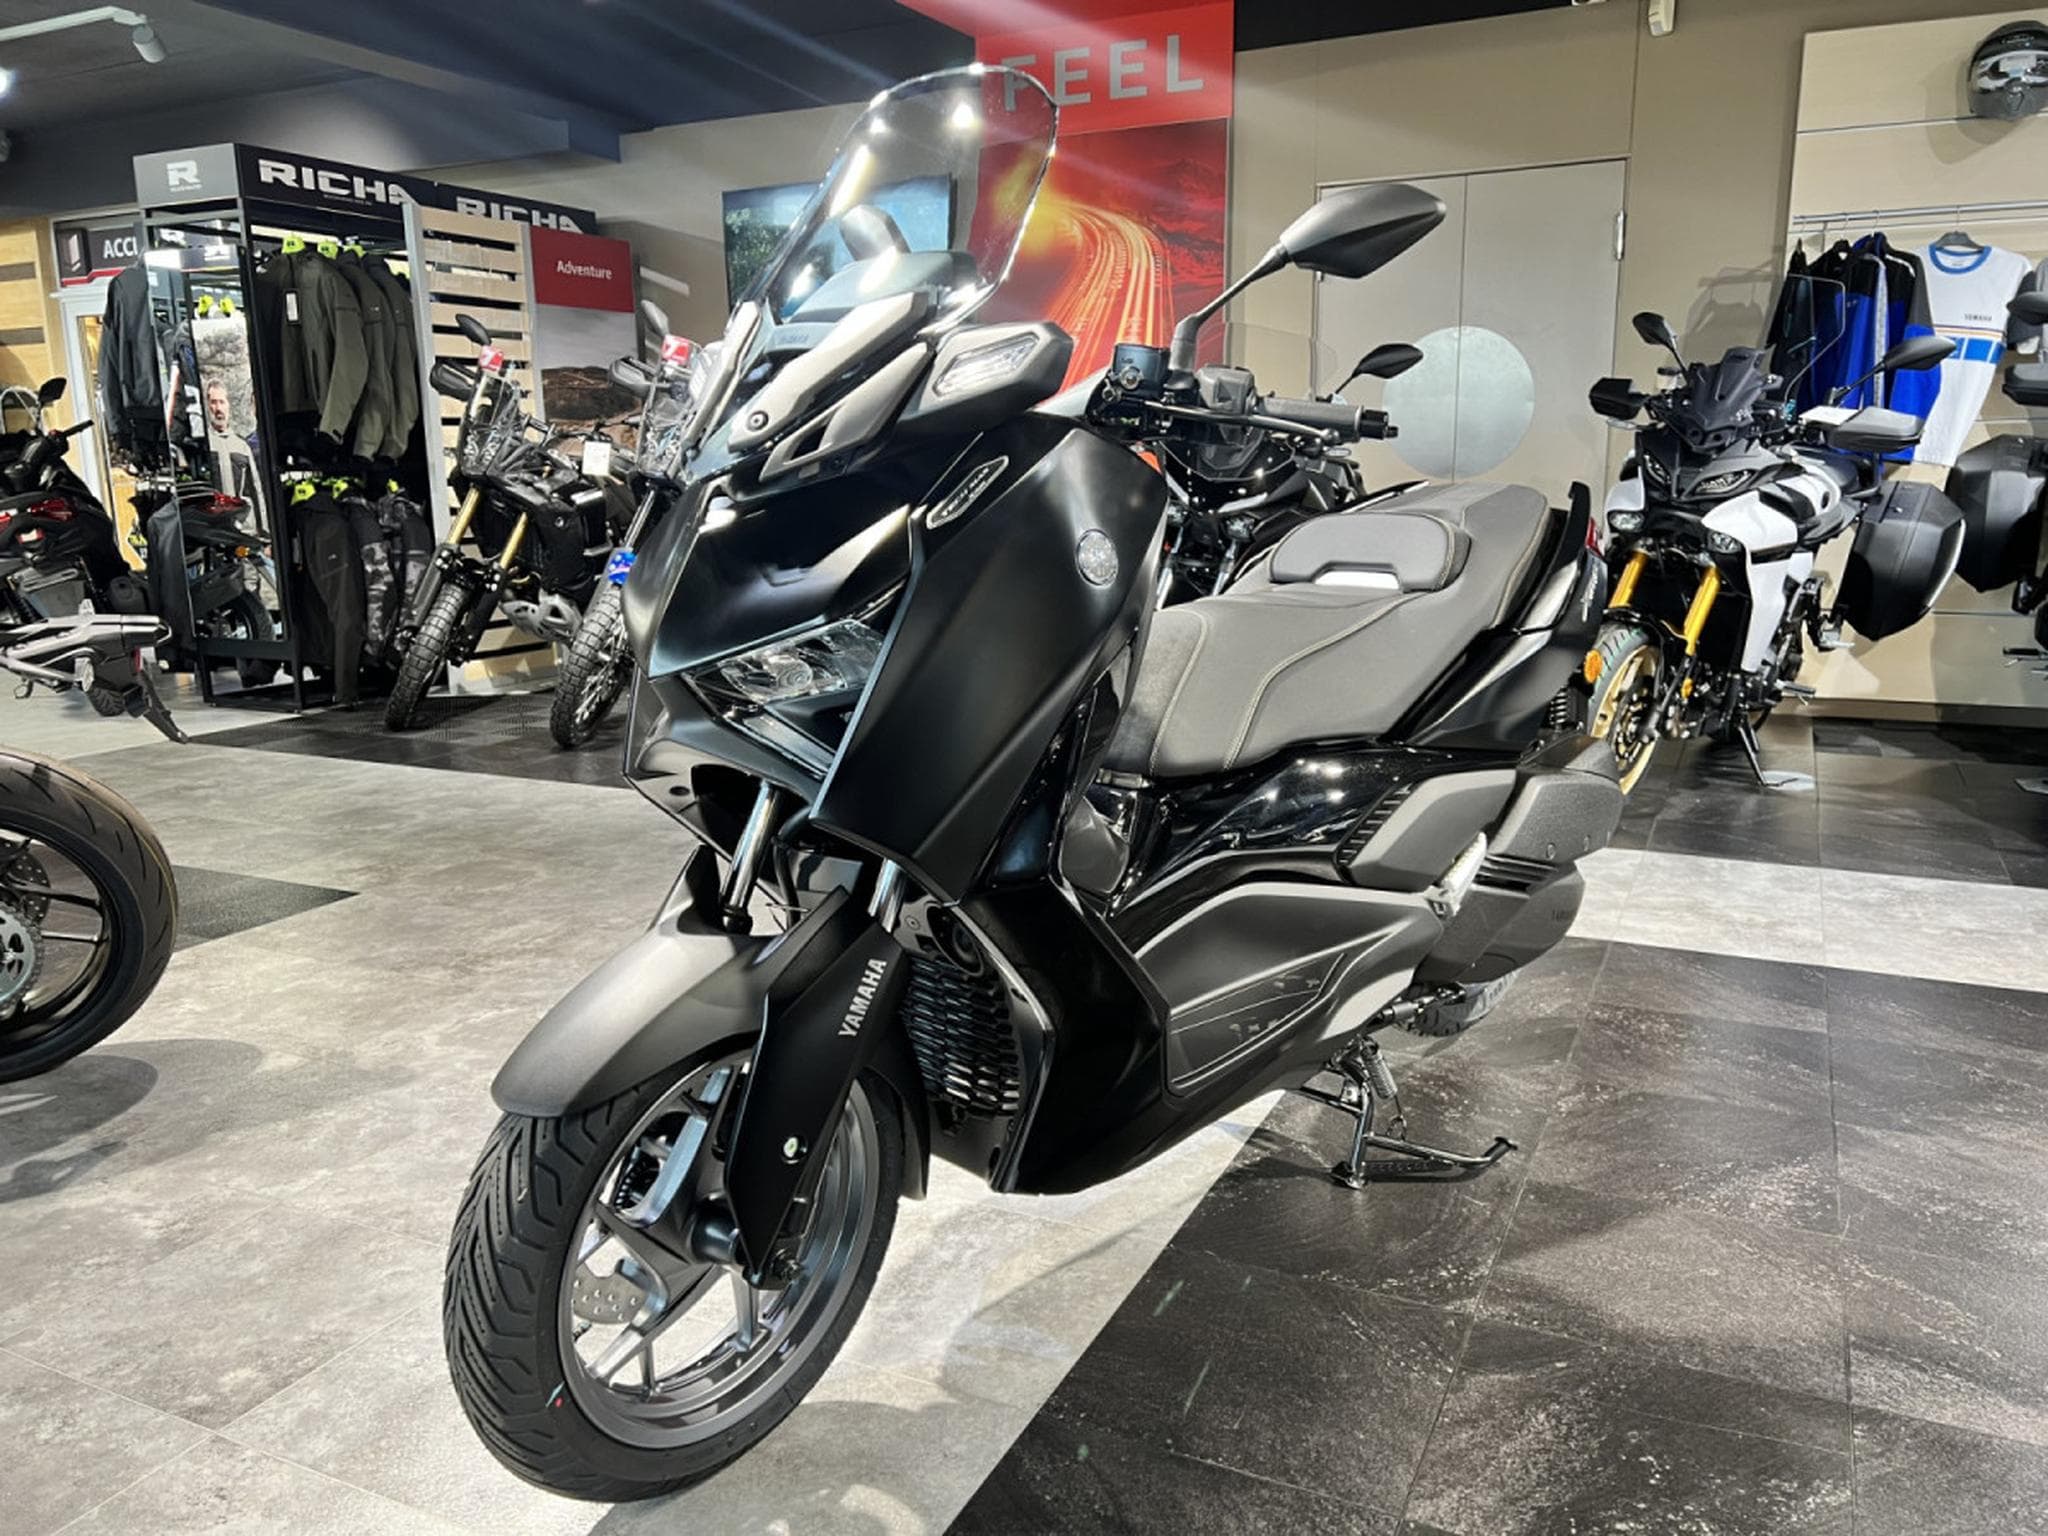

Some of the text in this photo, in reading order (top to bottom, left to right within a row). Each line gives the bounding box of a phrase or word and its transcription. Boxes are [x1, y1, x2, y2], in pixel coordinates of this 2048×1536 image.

[1001, 34, 1204, 112] FEEL
[167, 160, 201, 186] R
[258, 159, 417, 205] RICHA
[556, 260, 613, 280] Adventure
[838, 958, 887, 1037] YAMAHA
